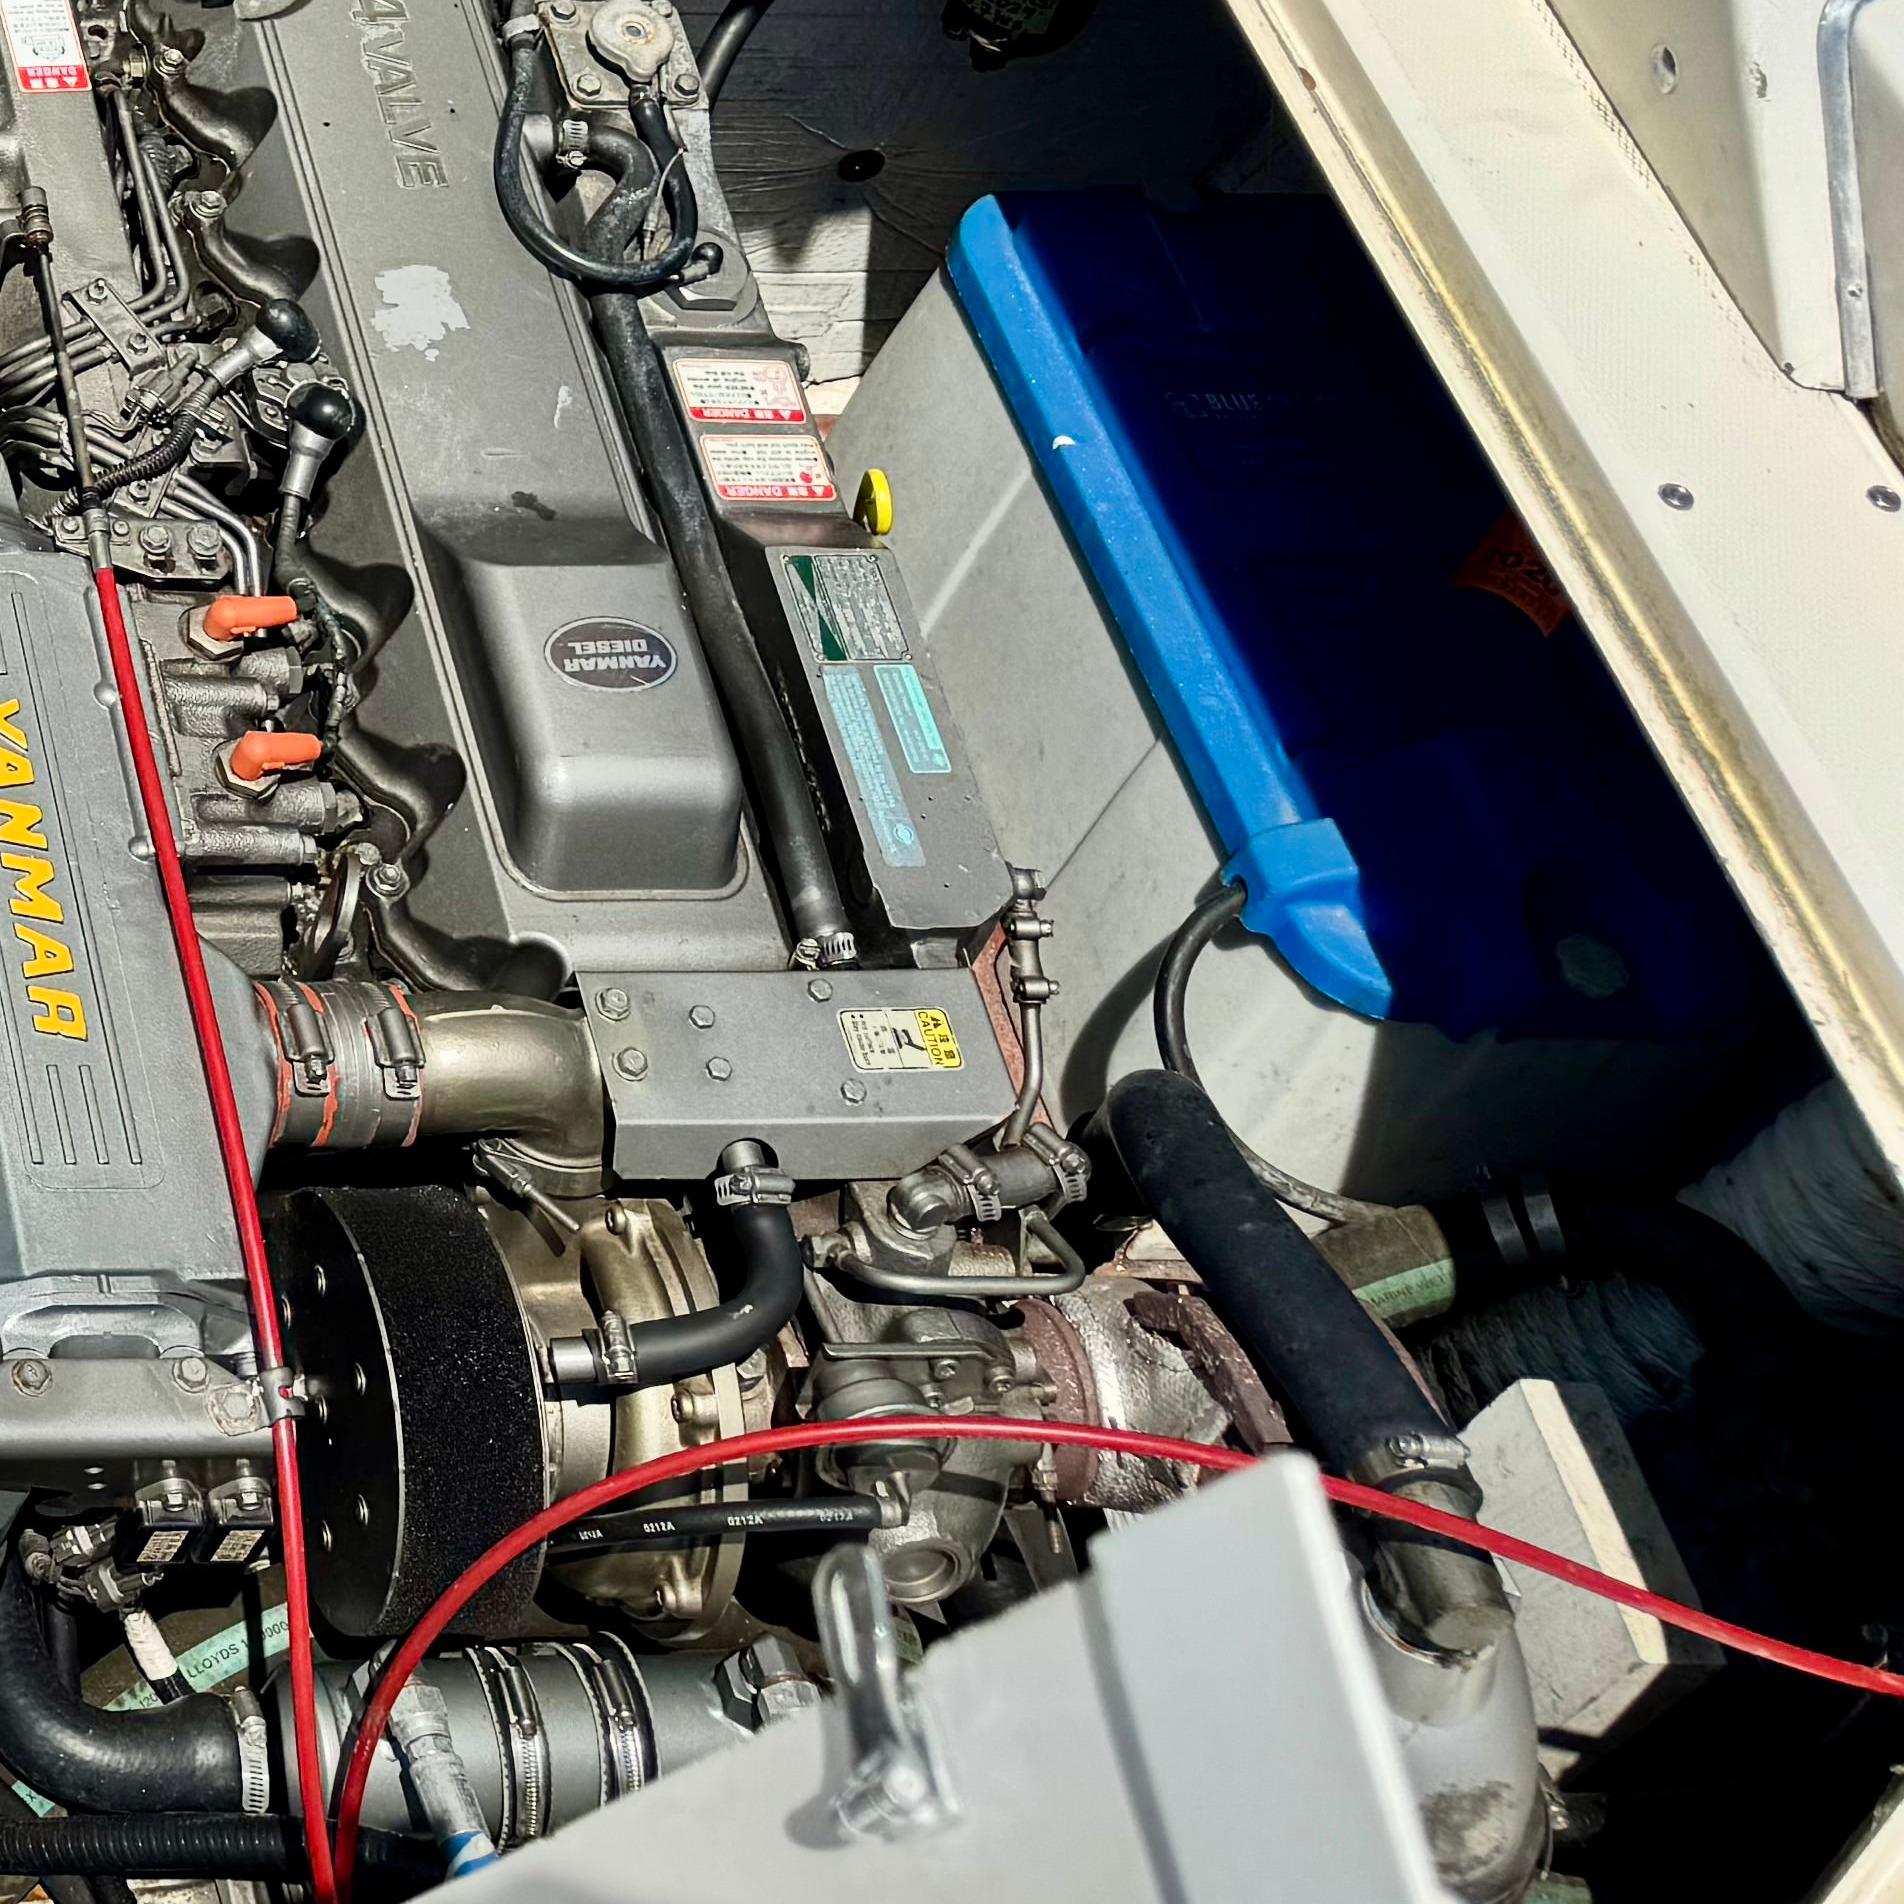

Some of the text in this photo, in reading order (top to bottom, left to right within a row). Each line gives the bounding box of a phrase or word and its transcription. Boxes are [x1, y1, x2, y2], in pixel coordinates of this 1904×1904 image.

[362, 25, 449, 189] VALVE
[704, 407, 750, 419] DANGER
[731, 485, 782, 497] DANGER
[566, 639, 648, 656] DIESEL
[563, 654, 667, 673] YANMAR
[918, 1011, 944, 1065] CAUTION
[185, 1643, 240, 1678] LLOYDS
